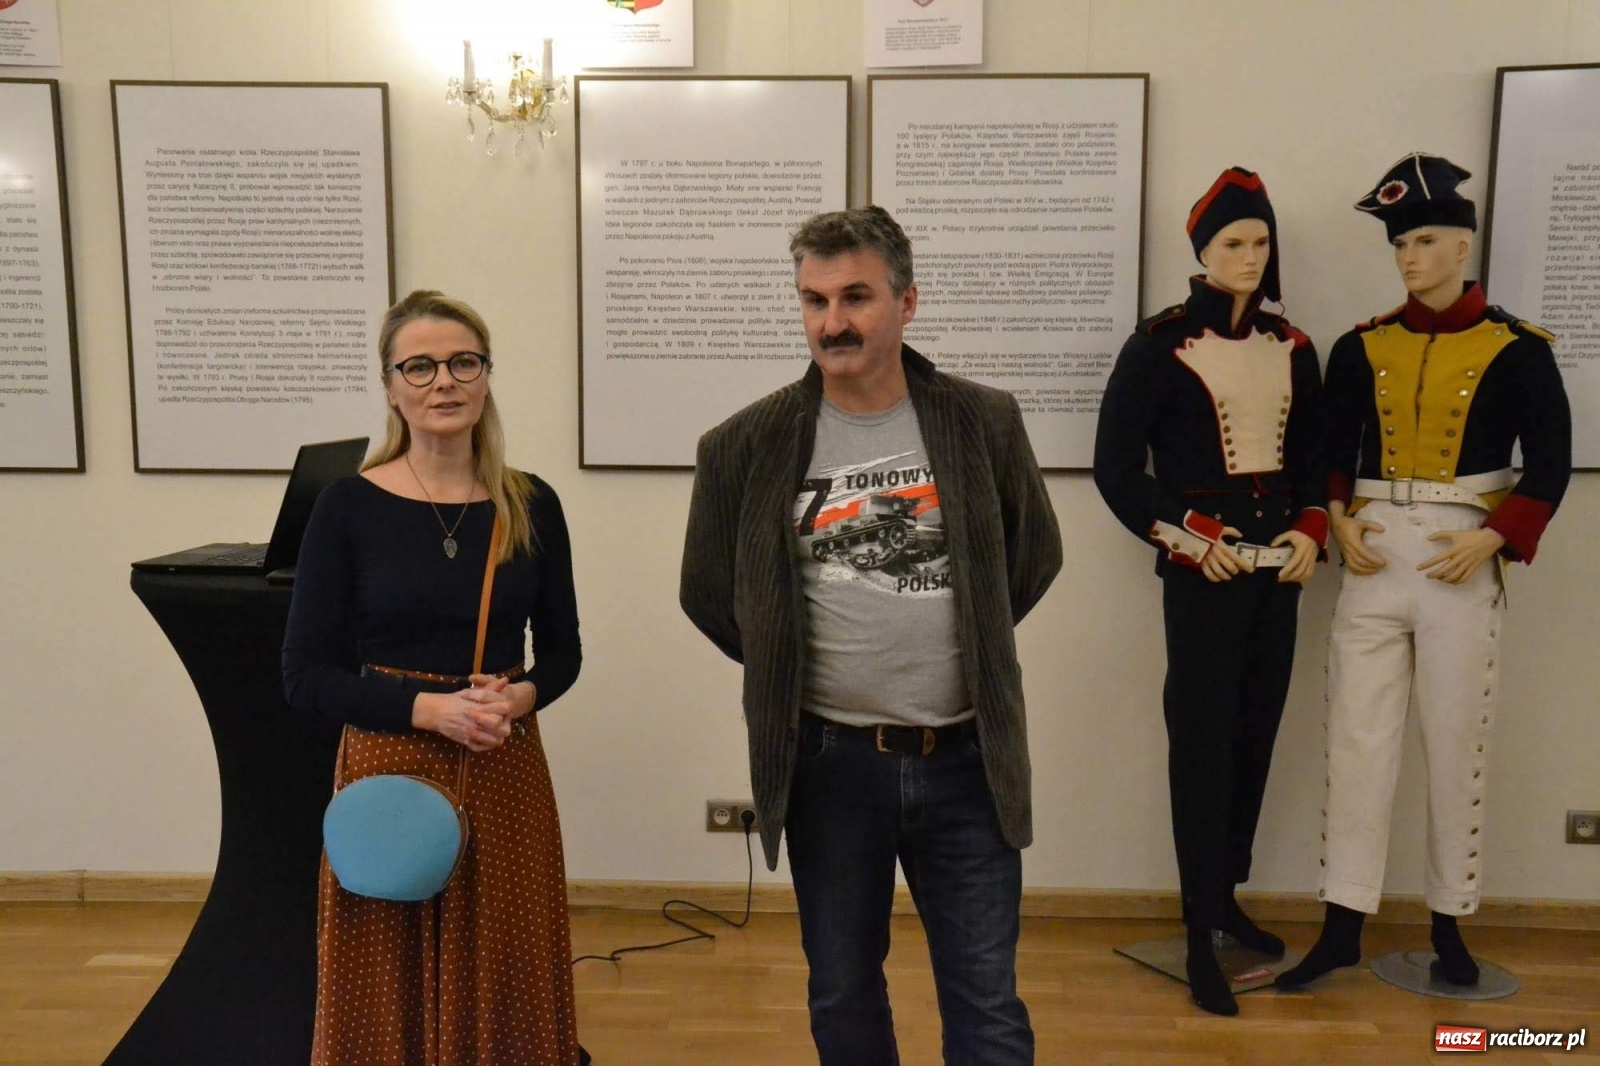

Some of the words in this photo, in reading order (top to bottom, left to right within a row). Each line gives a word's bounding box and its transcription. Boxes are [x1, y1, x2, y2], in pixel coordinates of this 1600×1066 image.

[686, 160, 723, 169] Napoleona
[639, 172, 663, 181] zostały
[708, 172, 732, 181] legiony
[803, 173, 822, 181] przez
[642, 184, 671, 193] Henryka
[726, 184, 744, 193] Miały
[796, 184, 822, 193] Francję
[679, 208, 733, 218] Dąbrowskiego
[695, 220, 706, 230] się
[942, 224, 966, 234] Polacy
[630, 257, 665, 266] pokonaniu
[709, 257, 733, 266] wojska
[993, 261, 1007, 271] pod
[637, 282, 657, 290] przez
[936, 280, 960, 289] Polacy
[606, 305, 643, 314] pruskiego
[647, 305, 681, 314] Księstwo
[937, 352, 961, 361] Polacy
[799, 478, 832, 536] 7
[844, 467, 934, 490] TONOWY
[896, 572, 952, 594] POLSK
